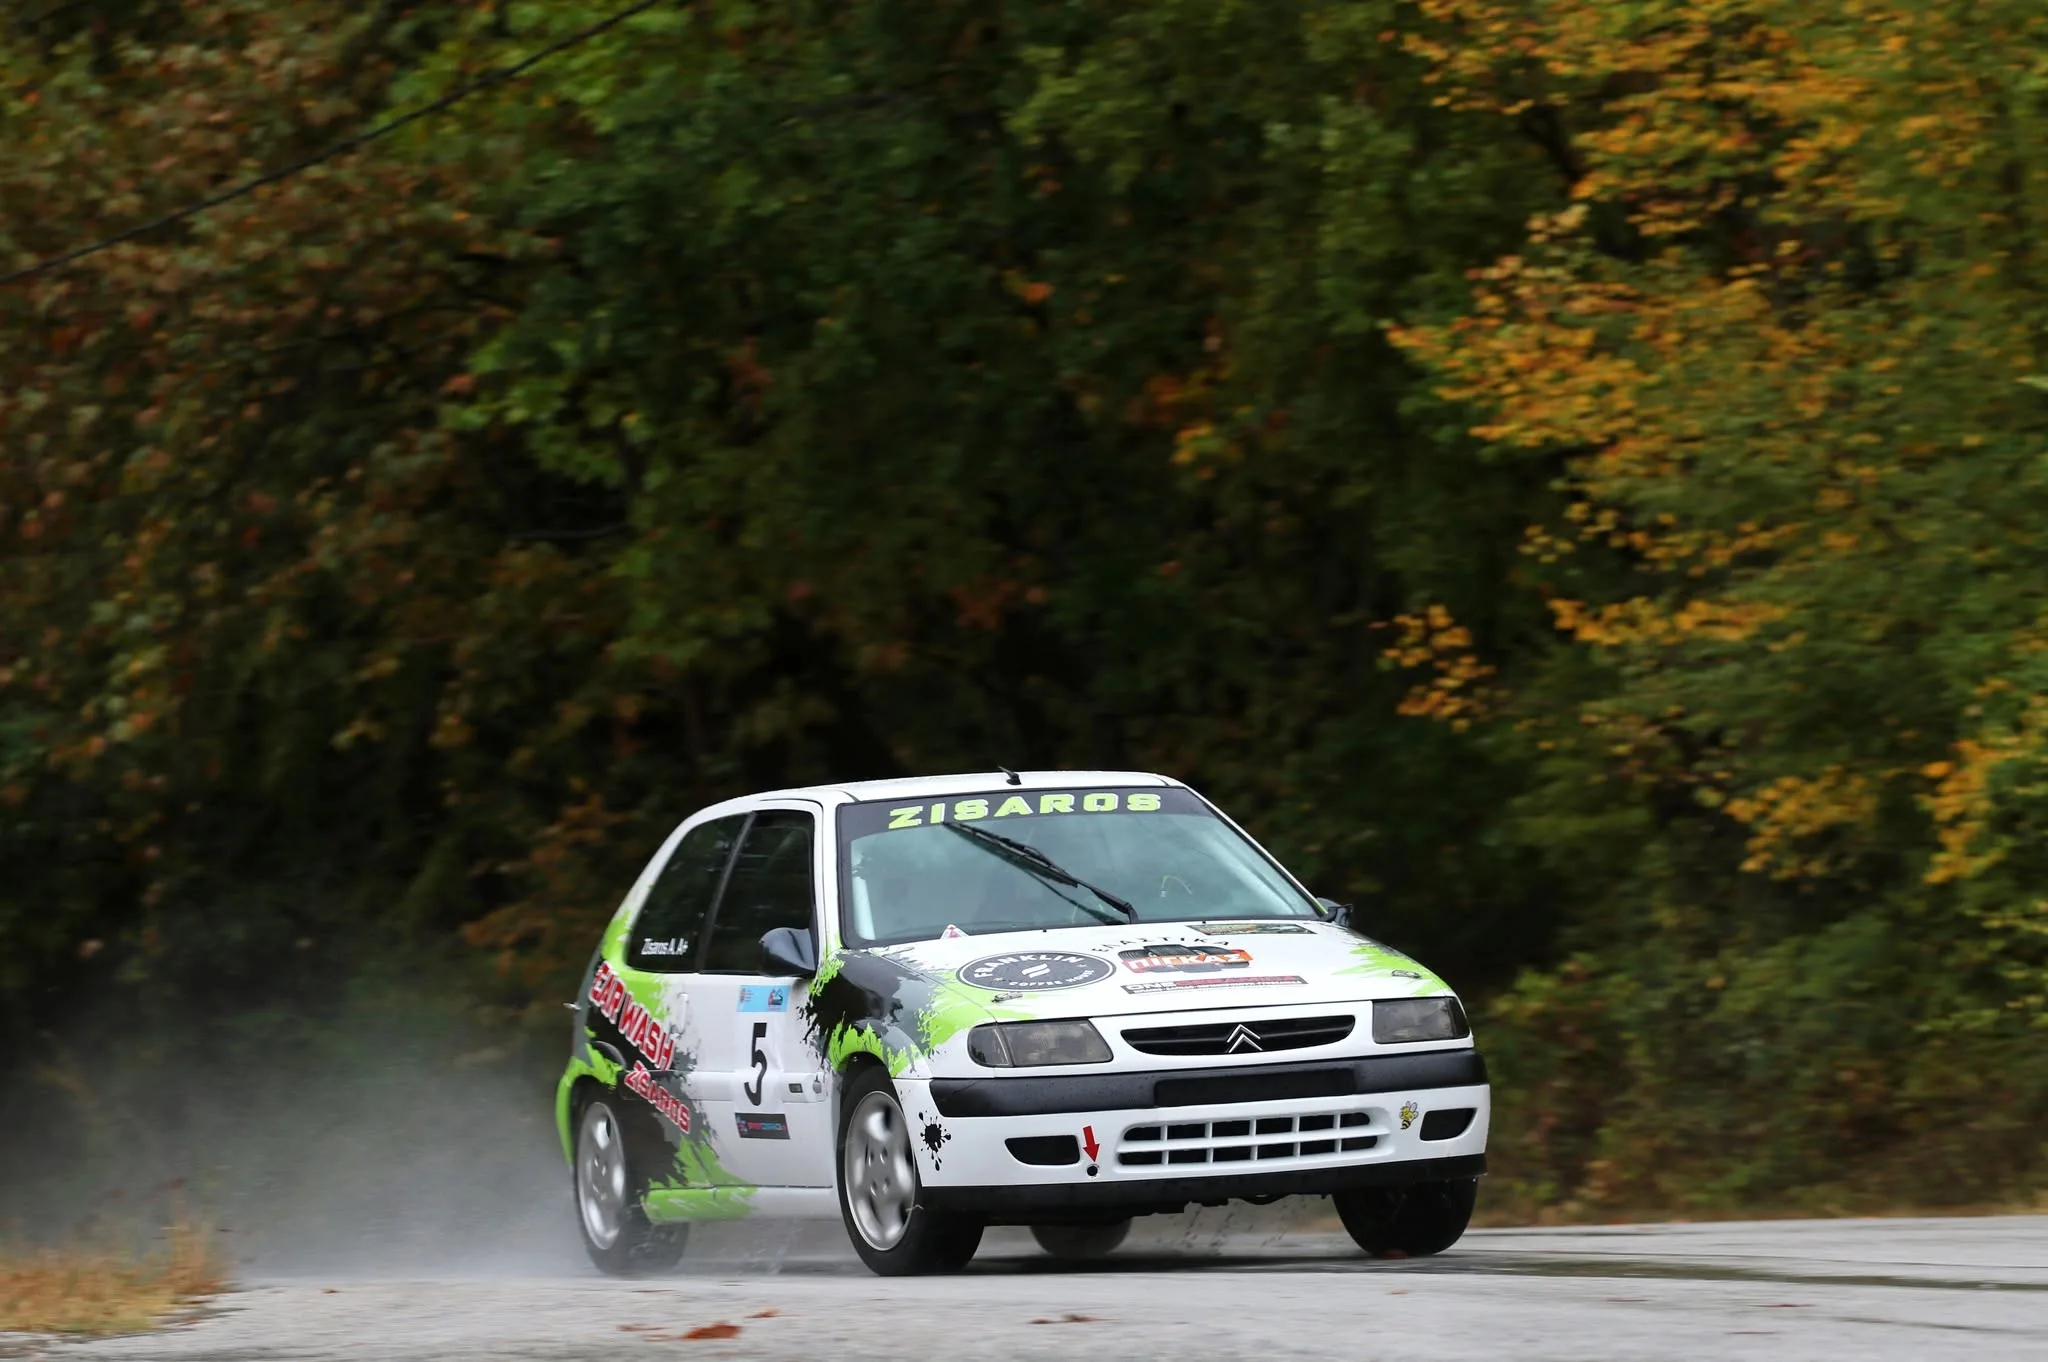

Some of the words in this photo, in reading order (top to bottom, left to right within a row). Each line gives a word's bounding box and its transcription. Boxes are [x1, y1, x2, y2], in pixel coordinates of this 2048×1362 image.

[888, 793, 1161, 829] ZISAROS
[974, 954, 1084, 978] FRANKLIN
[618, 991, 676, 1071] WASH
[743, 1022, 768, 1107] 5
